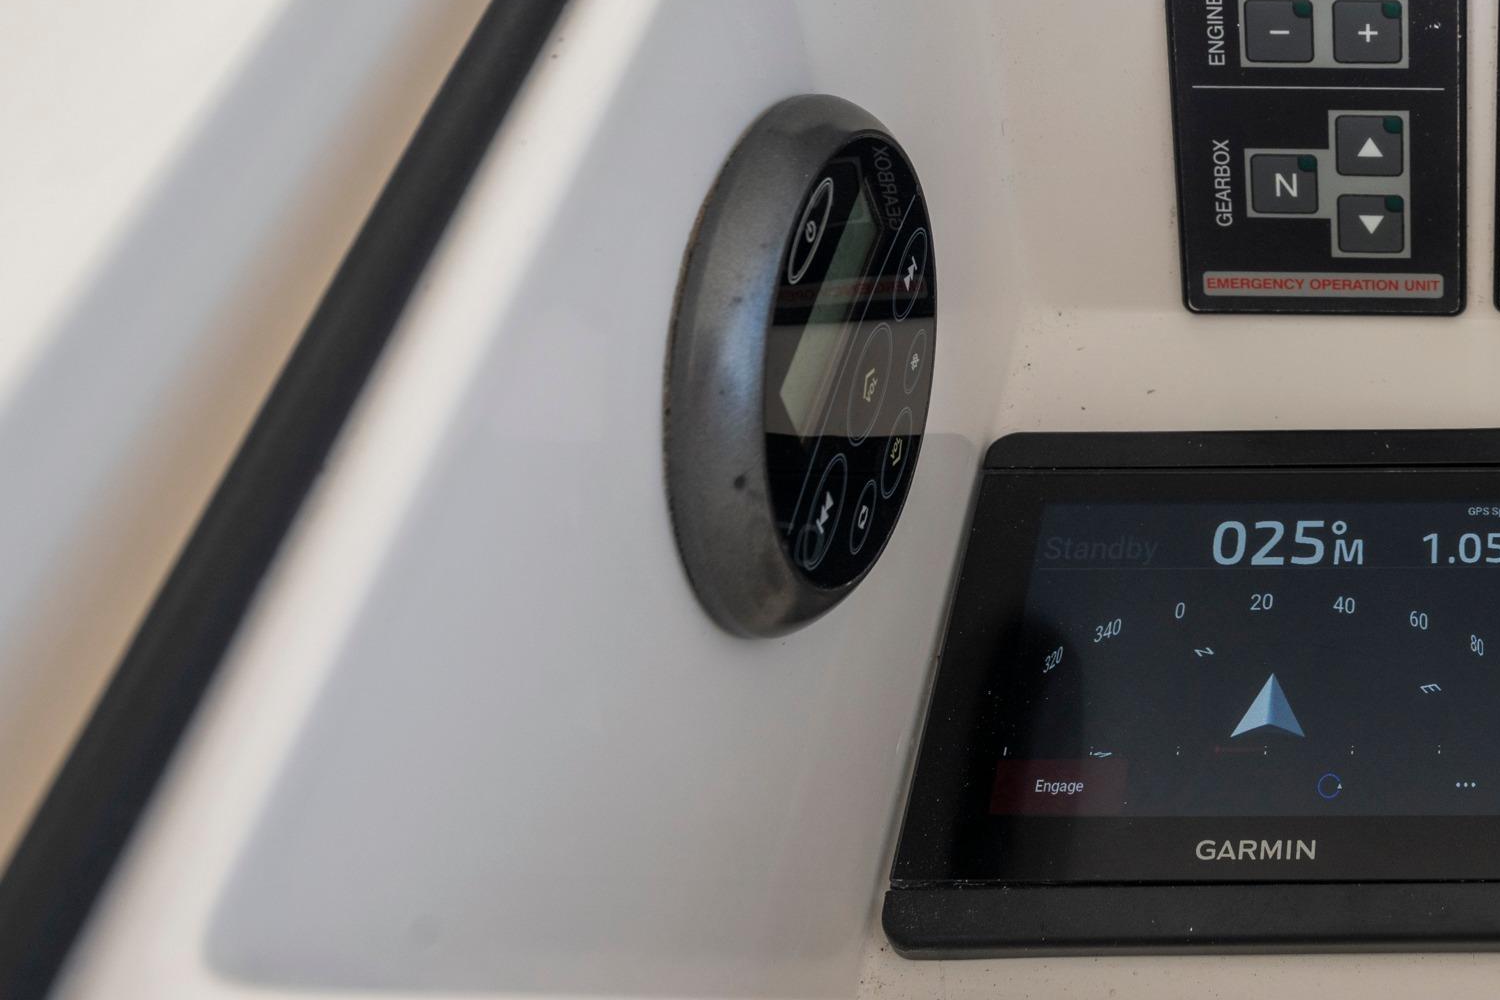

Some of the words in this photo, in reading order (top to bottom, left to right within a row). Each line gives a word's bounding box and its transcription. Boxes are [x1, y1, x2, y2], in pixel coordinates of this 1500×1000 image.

[1212, 139, 1233, 227] GEARBOX
[1275, 172, 1298, 198] N
[1206, 277, 1304, 291] EMERGENCY
[1309, 278, 1399, 292] OPERATION
[1404, 279, 1441, 292] UNIT
[1467, 506, 1490, 517] GPS
[1043, 535, 1160, 565] Standby
[1174, 602, 1186, 619] 0
[1249, 593, 1274, 611] 20
[1332, 597, 1356, 614] 40
[1093, 617, 1122, 644] 340
[1409, 610, 1429, 630] 60
[1469, 634, 1485, 657] 80
[1042, 645, 1064, 674] 320
[1034, 778, 1084, 796] Engage
[1195, 839, 1317, 861] GARMIN
